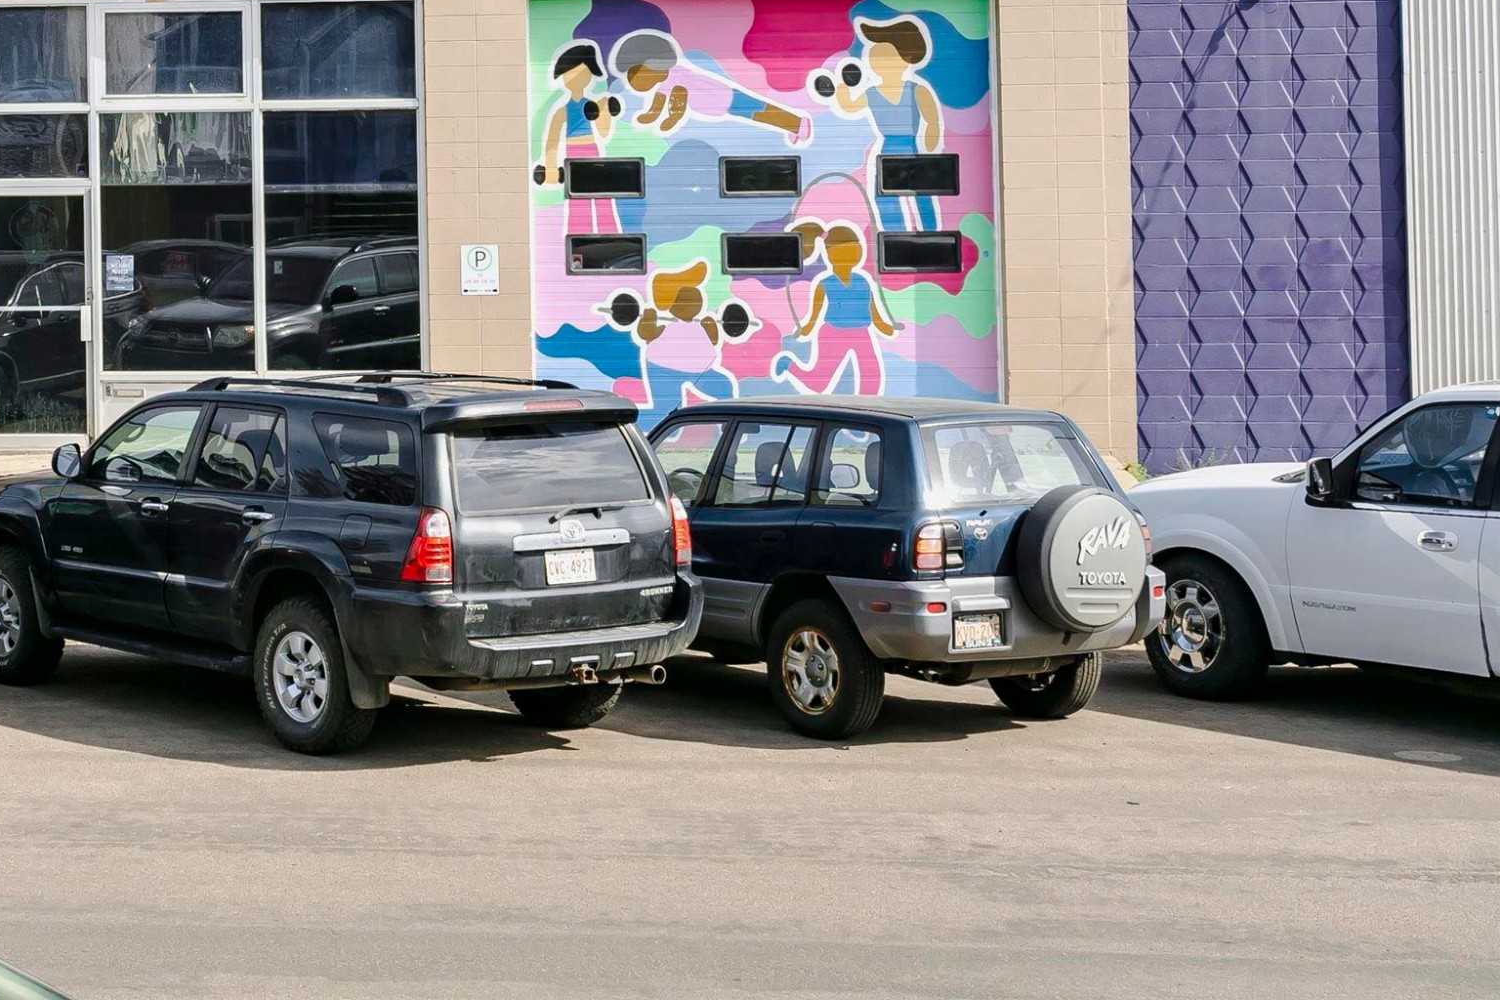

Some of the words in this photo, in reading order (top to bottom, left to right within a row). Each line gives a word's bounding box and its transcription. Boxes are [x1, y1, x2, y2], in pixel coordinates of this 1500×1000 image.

[475, 250, 487, 268] P
[1079, 571, 1127, 586] TOYOTA
[640, 585, 674, 597] 4RUNNER
